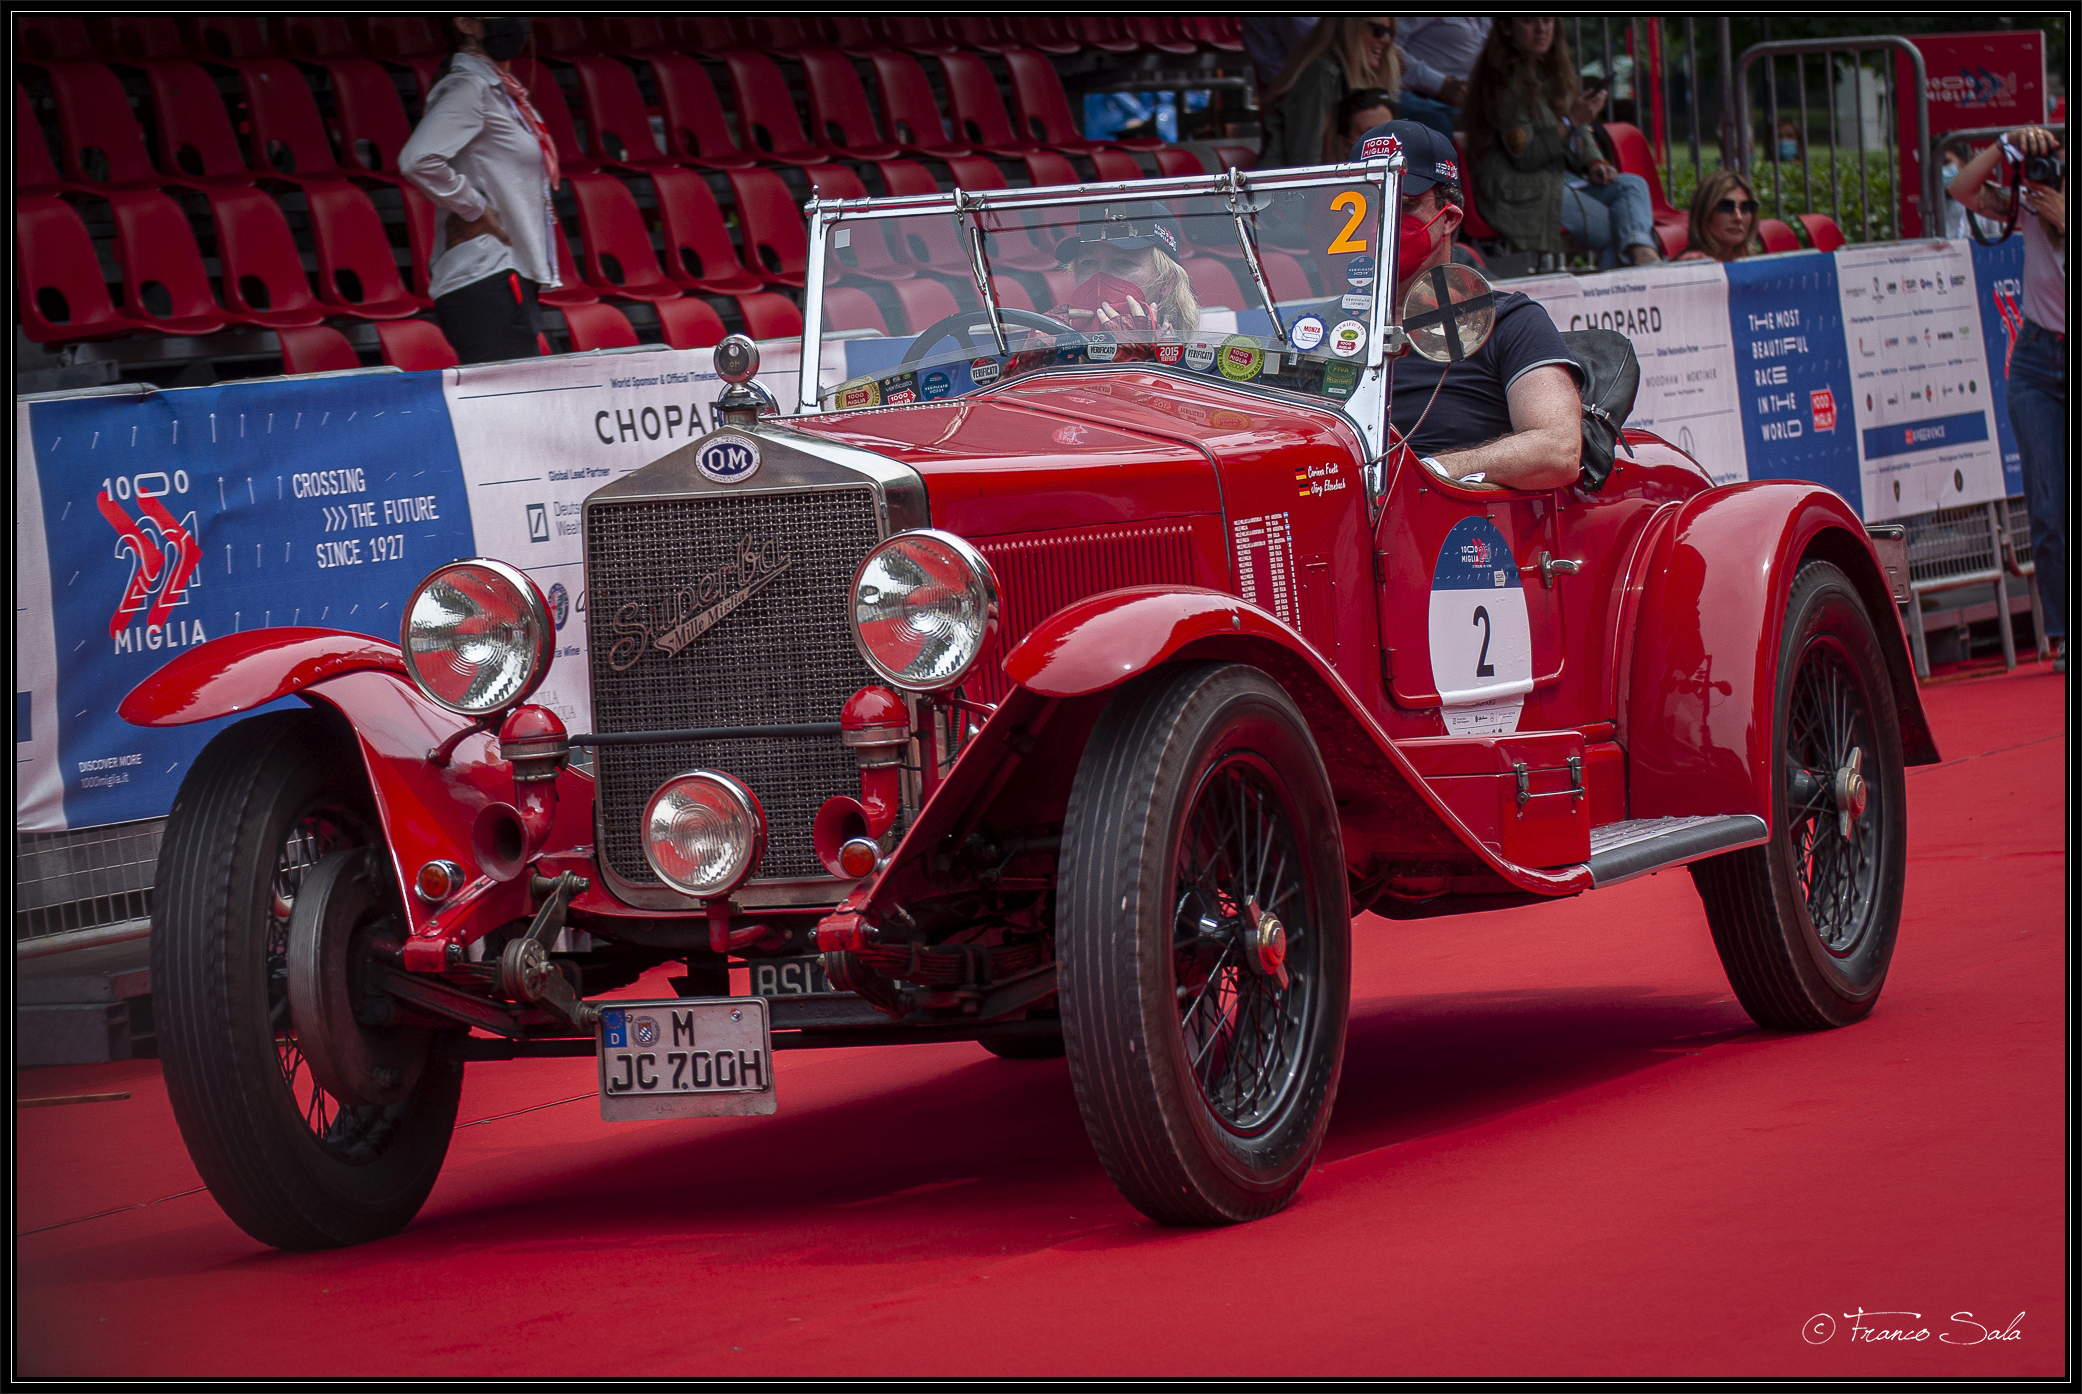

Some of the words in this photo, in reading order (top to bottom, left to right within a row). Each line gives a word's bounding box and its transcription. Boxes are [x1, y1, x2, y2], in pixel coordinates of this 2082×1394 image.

[1363, 147, 1390, 157] MIGLIA
[1367, 139, 1390, 148] 1000
[1327, 191, 1367, 255] 2
[1303, 325, 1321, 333] MONZA
[1570, 306, 1662, 335] CHOPARD
[1748, 311, 1775, 332] THE
[1775, 308, 1801, 328] MOST
[1090, 345, 1115, 354] VERIFICATO
[1159, 346, 1179, 357] 2015
[1187, 349, 1213, 361] VERIFICATO
[1232, 349, 1249, 359] 1000
[1751, 335, 1809, 360] BEAUTIFUL
[1229, 355, 1248, 364] MIGLIA
[1333, 365, 1349, 373] FIVA
[972, 365, 998, 379] VERIFICATO
[1754, 365, 1788, 387] RACE
[610, 377, 631, 389] World
[884, 380, 913, 392] verificato
[847, 397, 866, 406] MIGLIA
[848, 392, 865, 400] 1000
[890, 392, 909, 402] 1000
[1757, 396, 1770, 414] IN
[1770, 392, 1797, 413] THE
[1761, 419, 1803, 442] WORLD
[708, 447, 747, 471] OM
[102, 470, 190, 501] 1000
[292, 467, 366, 499] CROSSING
[348, 501, 378, 529] THE
[383, 495, 440, 525] FUTURE
[316, 539, 363, 568] SINCE
[369, 534, 404, 563] 1927
[1460, 545, 1479, 554] 1000
[607, 533, 791, 671] Superba
[672, 617, 706, 651] Mille
[706, 593, 746, 624] Miglia
[114, 618, 207, 655] MIGLIA
[1472, 605, 1495, 677] 2
[78, 757, 118, 773] DISCOVER
[119, 753, 142, 767] MORE
[671, 1008, 696, 1047] M
[610, 1032, 620, 1045] D
[611, 1052, 660, 1091] JC
[667, 1048, 763, 1089] 700H
